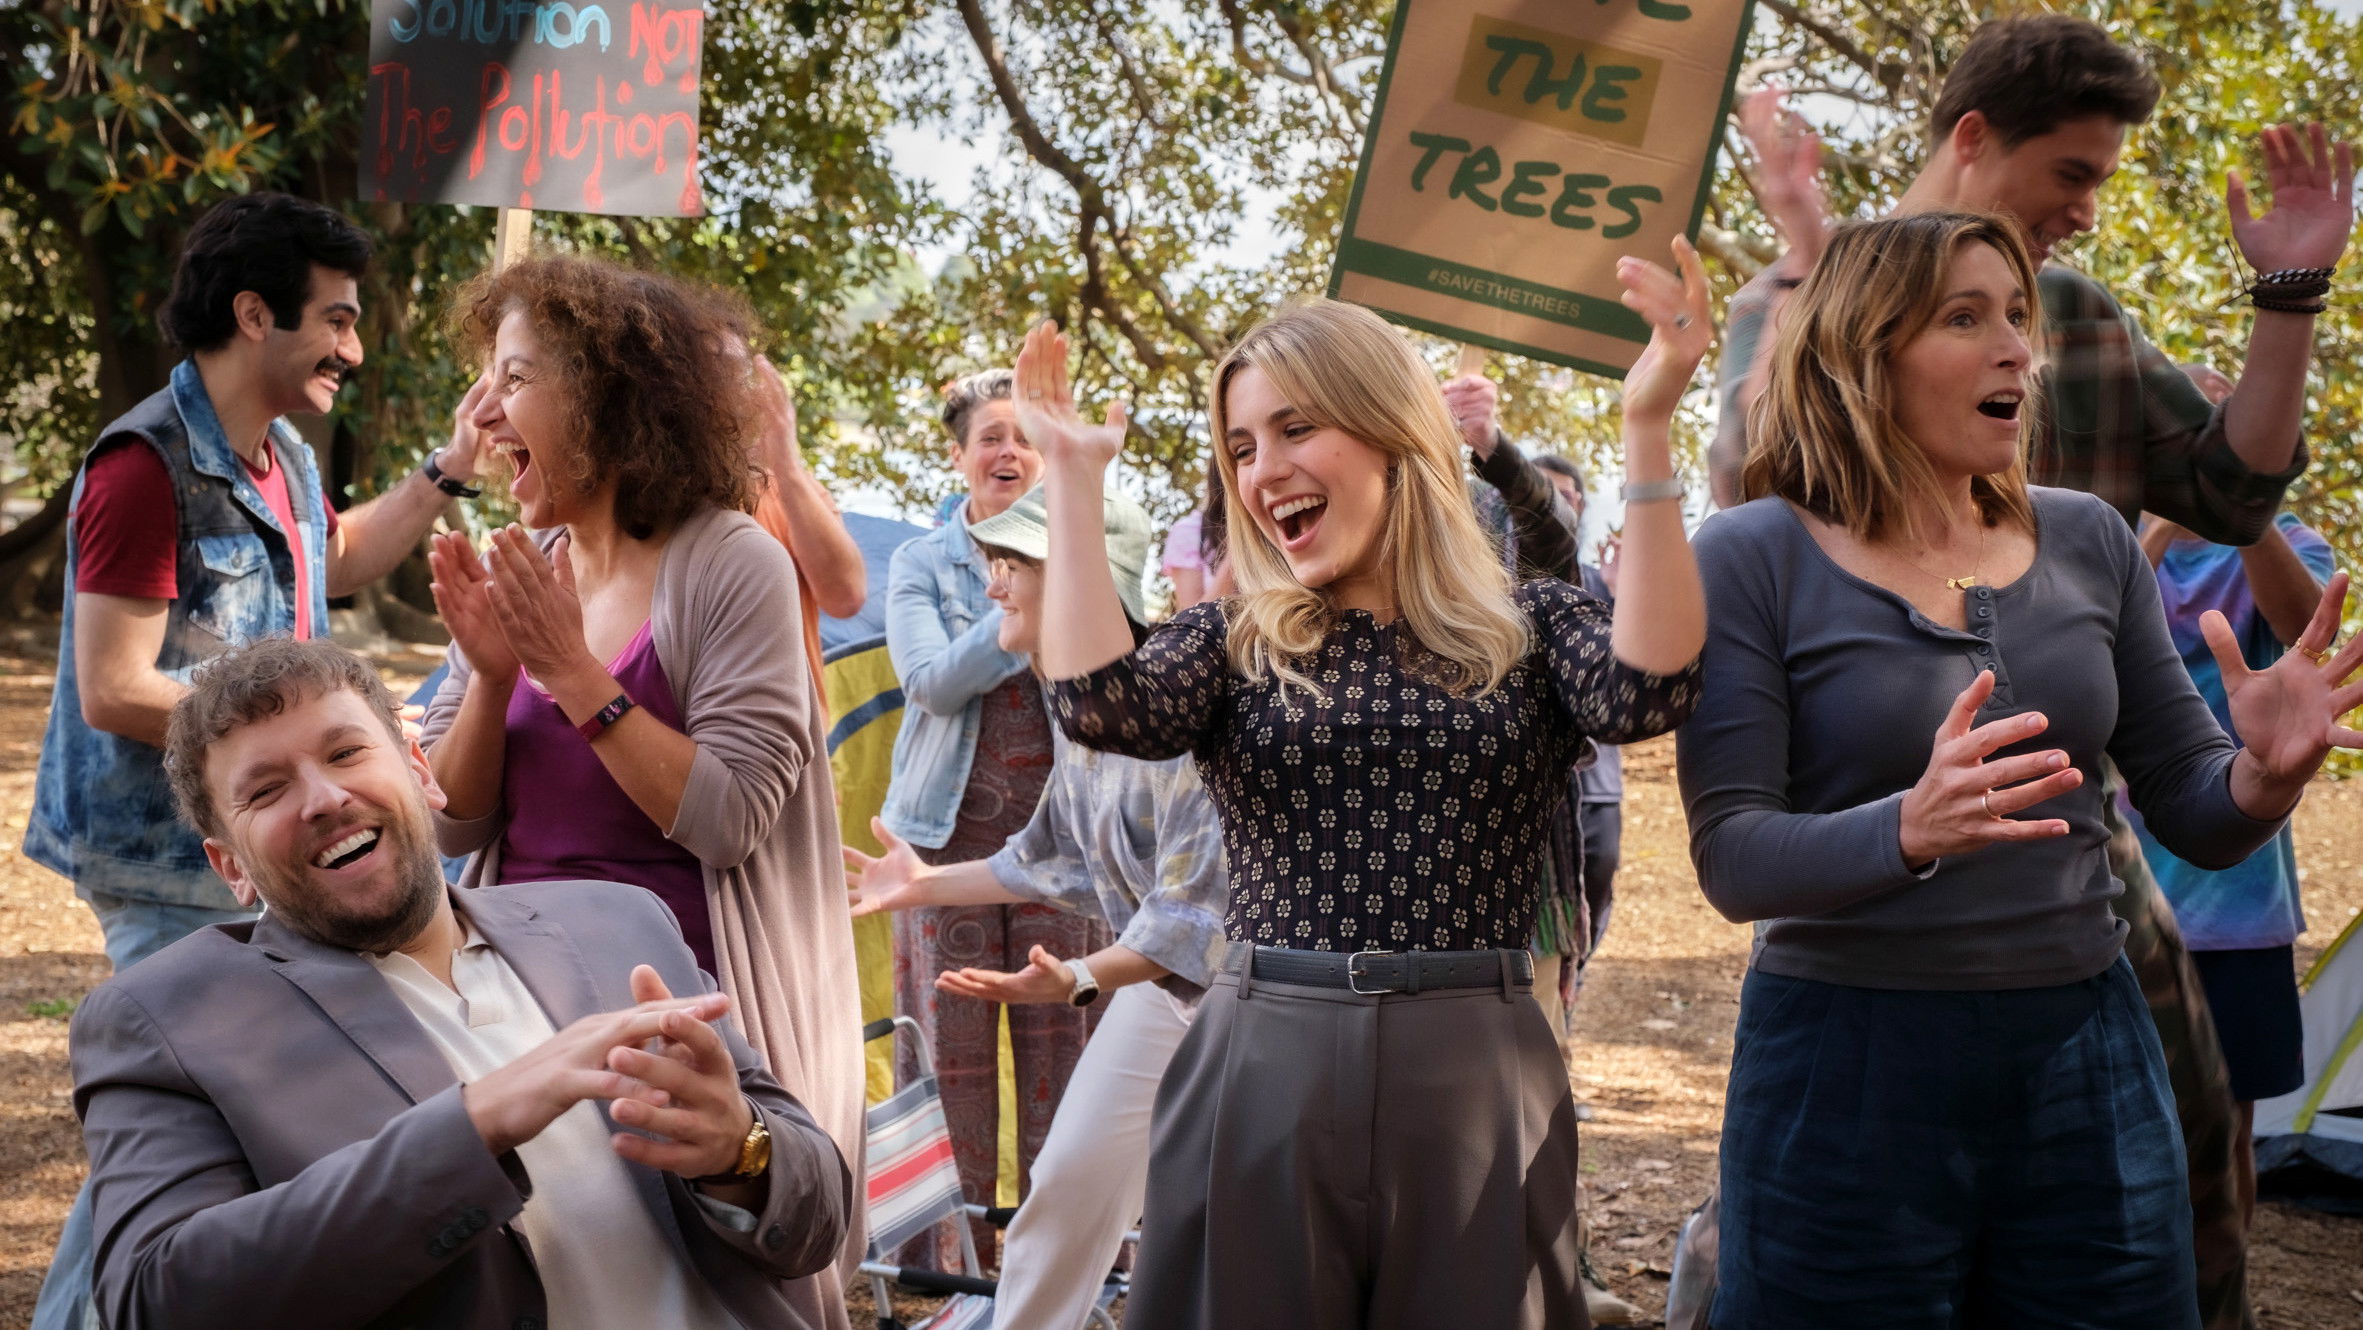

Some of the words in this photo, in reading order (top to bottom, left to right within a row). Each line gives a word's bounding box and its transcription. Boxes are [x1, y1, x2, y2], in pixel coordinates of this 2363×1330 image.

[389, 0, 612, 52] Solution
[628, 1, 705, 72] NOT
[1485, 34, 1643, 124] THE
[371, 61, 457, 172] The
[468, 61, 704, 202] Pollution
[1409, 130, 1663, 240] TREES
[1427, 268, 1581, 319] #SAVETHETREES
